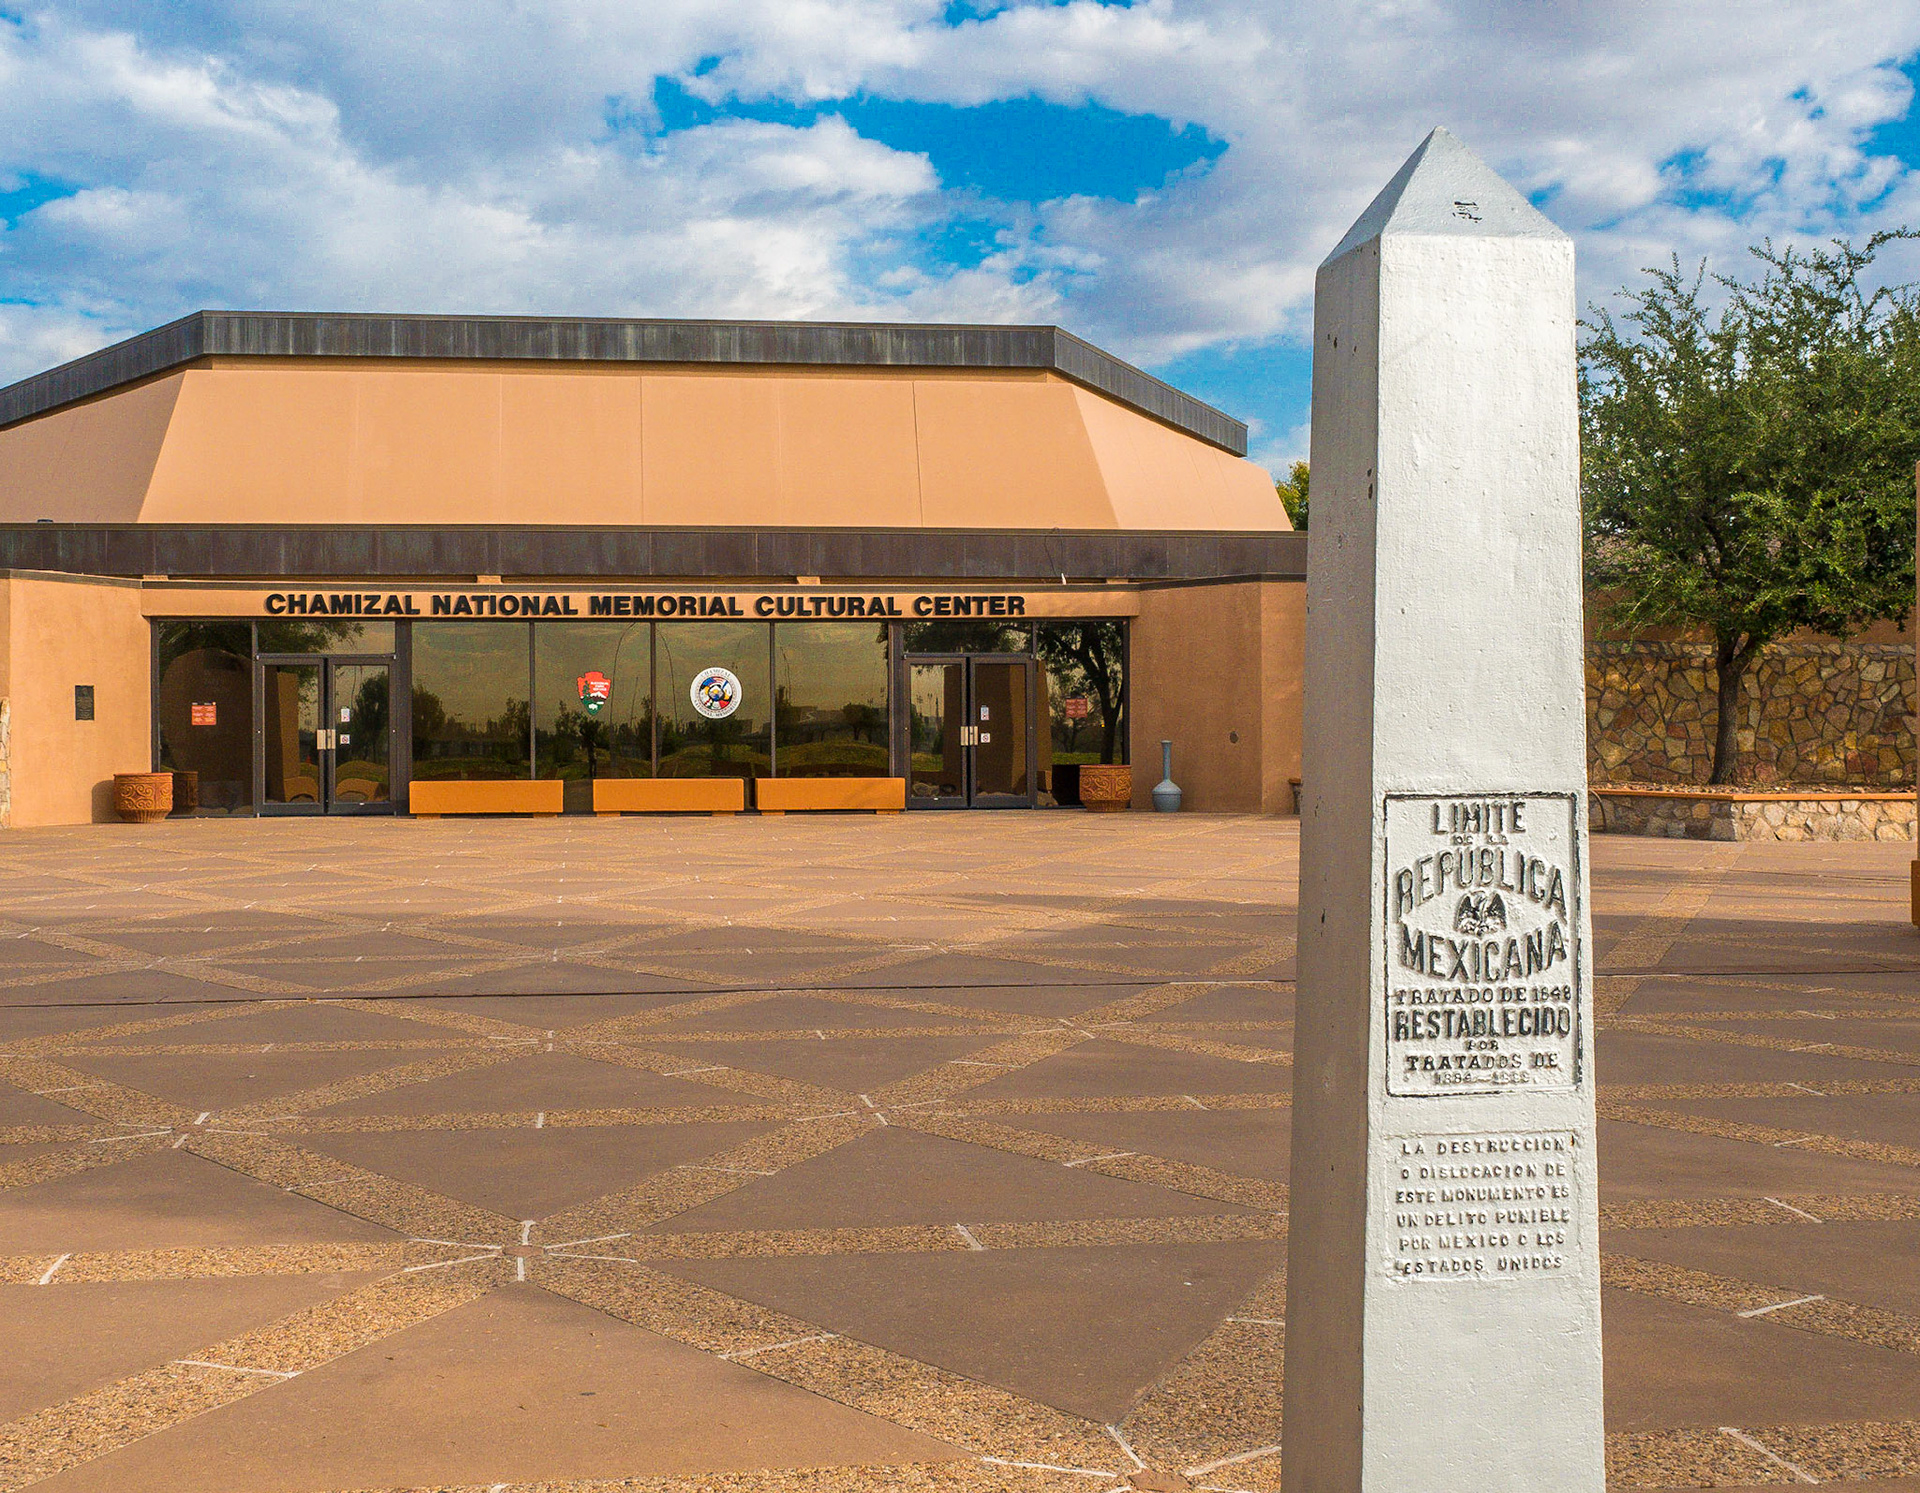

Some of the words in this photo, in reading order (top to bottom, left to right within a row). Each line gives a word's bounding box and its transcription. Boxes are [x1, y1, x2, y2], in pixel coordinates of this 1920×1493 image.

[265, 594, 421, 615] CHAMIZAL
[431, 595, 579, 616] NATIONAL
[589, 595, 744, 617] MEMORIAL
[754, 596, 902, 617] CULTURAL
[913, 596, 1026, 616] CENTER
[1431, 801, 1527, 834] LIMITE
[1396, 847, 1568, 924] REPUBLICA
[1400, 919, 1568, 983] MEXICANA
[1395, 986, 1494, 1005] TRATADO
[1501, 987, 1527, 1002] DE
[1533, 985, 1572, 1002] 1848
[1394, 1006, 1571, 1041] RESTABLECIDO
[1466, 1040, 1499, 1051] POR
[1405, 1053, 1522, 1071] TRATADOS
[1534, 1052, 1558, 1068] DE
[1402, 1140, 1425, 1155] LA
[1437, 1136, 1565, 1155] DESTRUCCION
[1420, 1165, 1537, 1180] DISLOCACION
[1545, 1163, 1566, 1178] DE
[1395, 1189, 1436, 1204] ESTE
[1442, 1186, 1546, 1203] MONUMENTO
[1551, 1184, 1570, 1199] ES
[1396, 1212, 1418, 1228] UN
[1425, 1211, 1488, 1227] DELITO
[1495, 1207, 1570, 1224] PUNIBLE
[1400, 1235, 1431, 1251] POR
[1438, 1234, 1510, 1249] MEXICO
[1537, 1231, 1565, 1247] LOS
[1403, 1258, 1484, 1275] ESTADOS
[1497, 1256, 1563, 1272] UNIDOS
